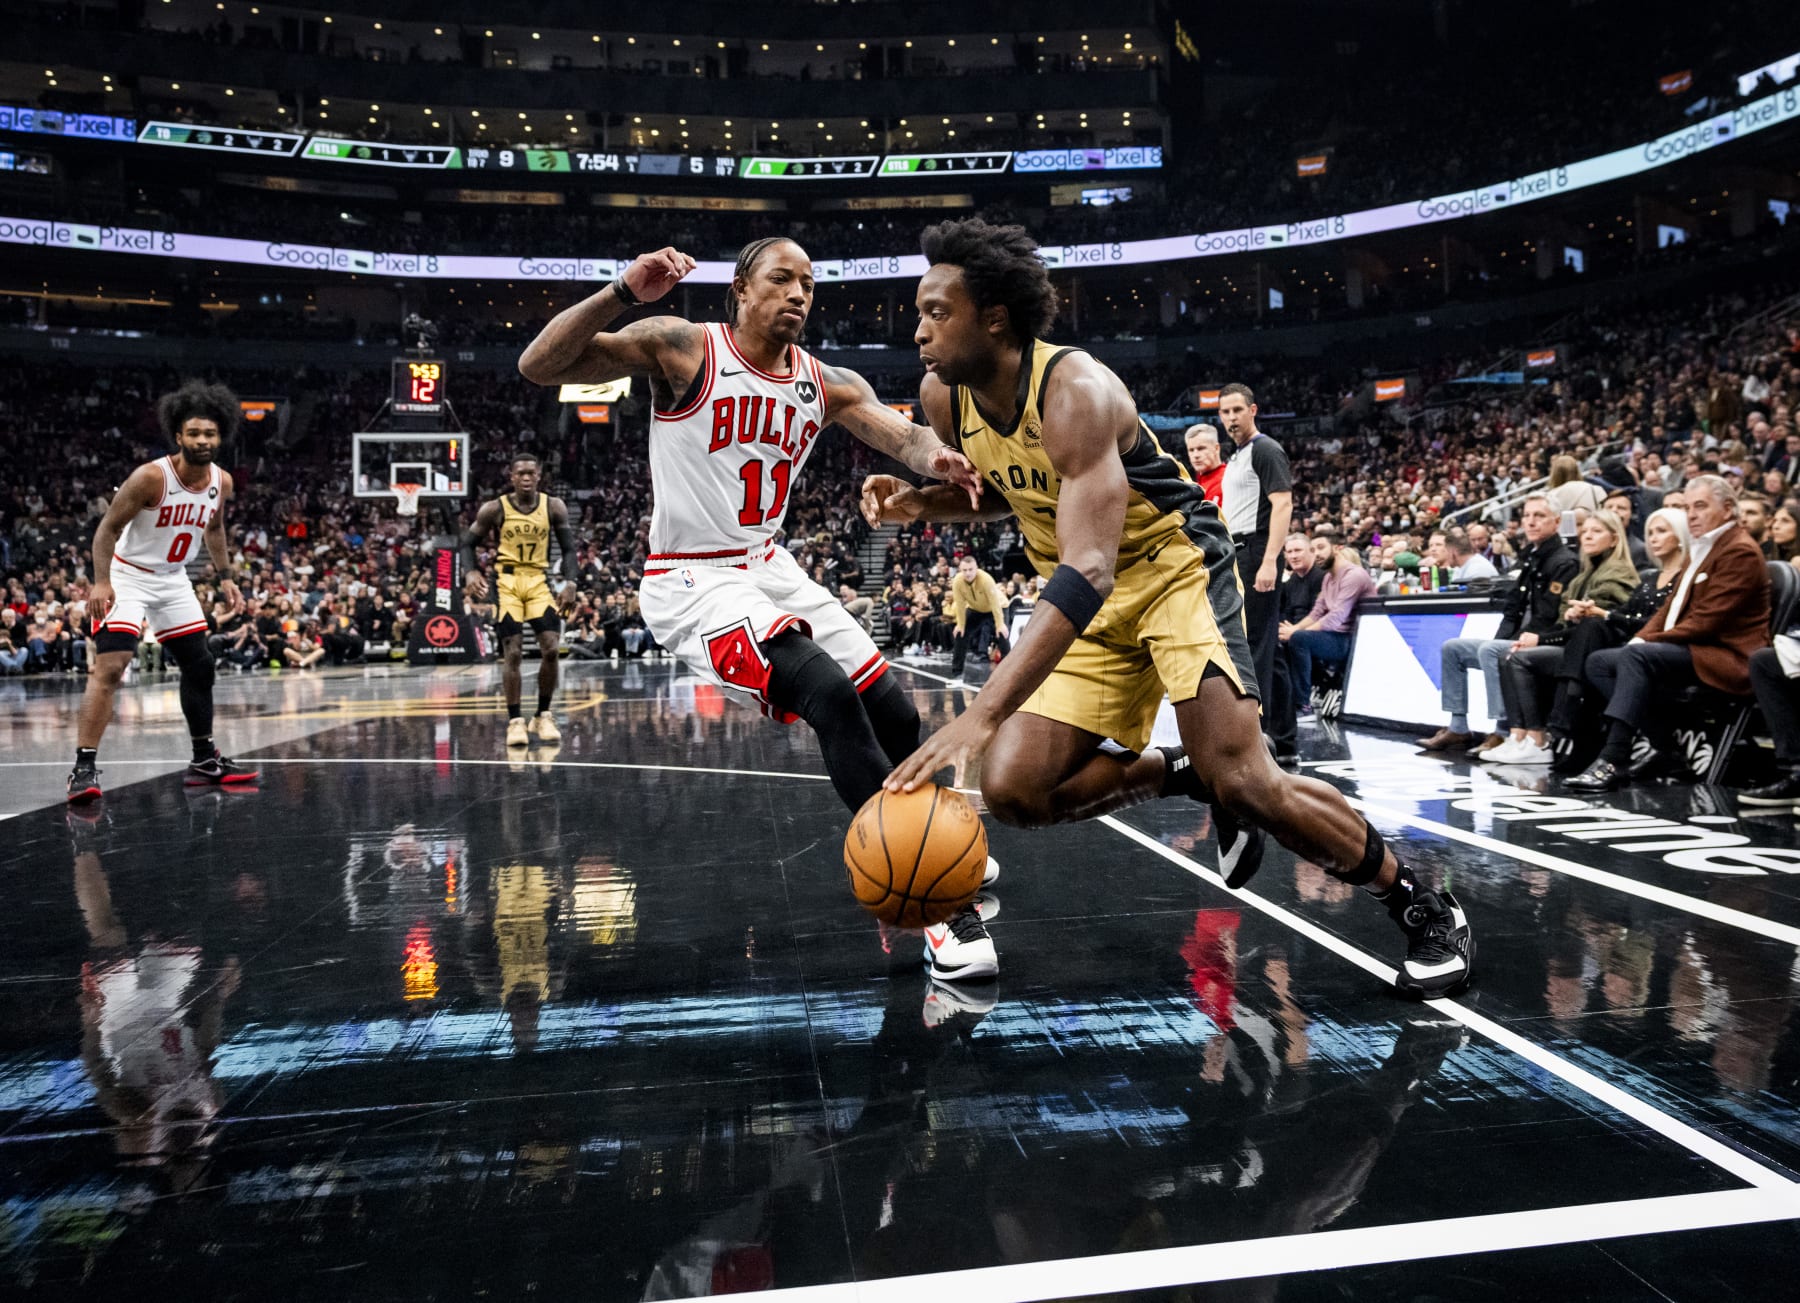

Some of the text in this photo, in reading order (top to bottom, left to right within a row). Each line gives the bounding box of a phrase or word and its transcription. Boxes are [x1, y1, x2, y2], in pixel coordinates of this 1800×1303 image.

[63, 112, 116, 135] Pixel
[122, 119, 135, 138] 8
[1644, 89, 1796, 162] Google Pixel 8
[223, 134, 234, 147] 2
[272, 138, 283, 151] 2
[499, 150, 514, 167] 9
[576, 153, 619, 171] 7:54
[690, 157, 704, 174] 5
[814, 163, 823, 174] 2
[854, 161, 863, 173] 2
[946, 159, 952, 170] 1
[986, 157, 993, 168] 1
[1014, 147, 1160, 170] Google Pixel 8
[1417, 168, 1567, 219] Google Pixel 8
[99, 227, 154, 249] Pixel
[162, 233, 175, 252] 8
[1194, 216, 1344, 252] Google Pixel 8
[266, 242, 438, 273] Google Pixel 8
[1063, 243, 1121, 263] Pixel 8
[518, 257, 593, 280] Google
[842, 256, 883, 276] Pixel
[888, 256, 899, 274] 8
[411, 379, 434, 402] 12
[708, 395, 819, 467] BULLS
[989, 464, 1062, 494] RON
[738, 459, 791, 527] 11
[167, 532, 193, 563] 0
[516, 543, 537, 561] 17
